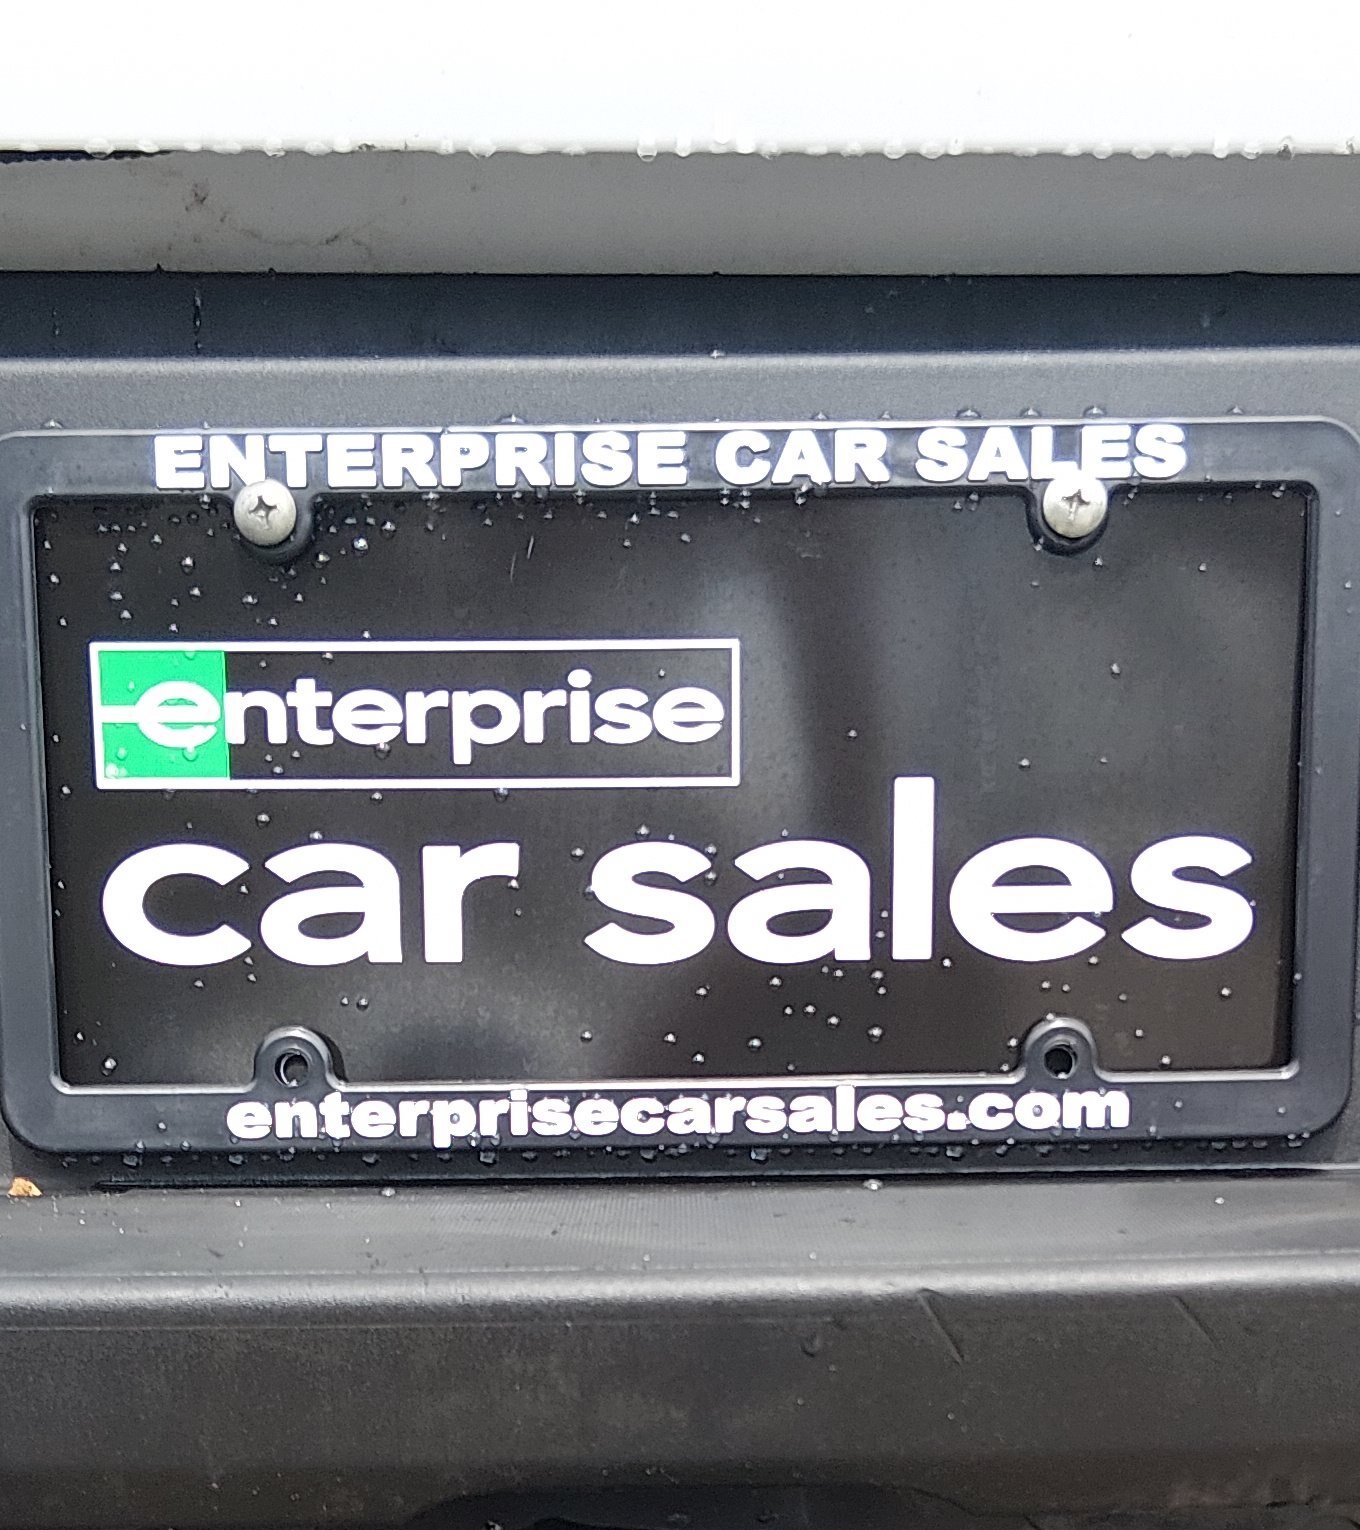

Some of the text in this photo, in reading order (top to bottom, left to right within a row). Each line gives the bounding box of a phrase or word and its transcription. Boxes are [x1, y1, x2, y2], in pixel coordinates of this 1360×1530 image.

[154, 424, 1187, 490] ENTERPRISE CAR SALES
[136, 668, 725, 766] enterprise
[101, 776, 1254, 967] car sales
[226, 1086, 1131, 1147] enterprisecarsales.com
